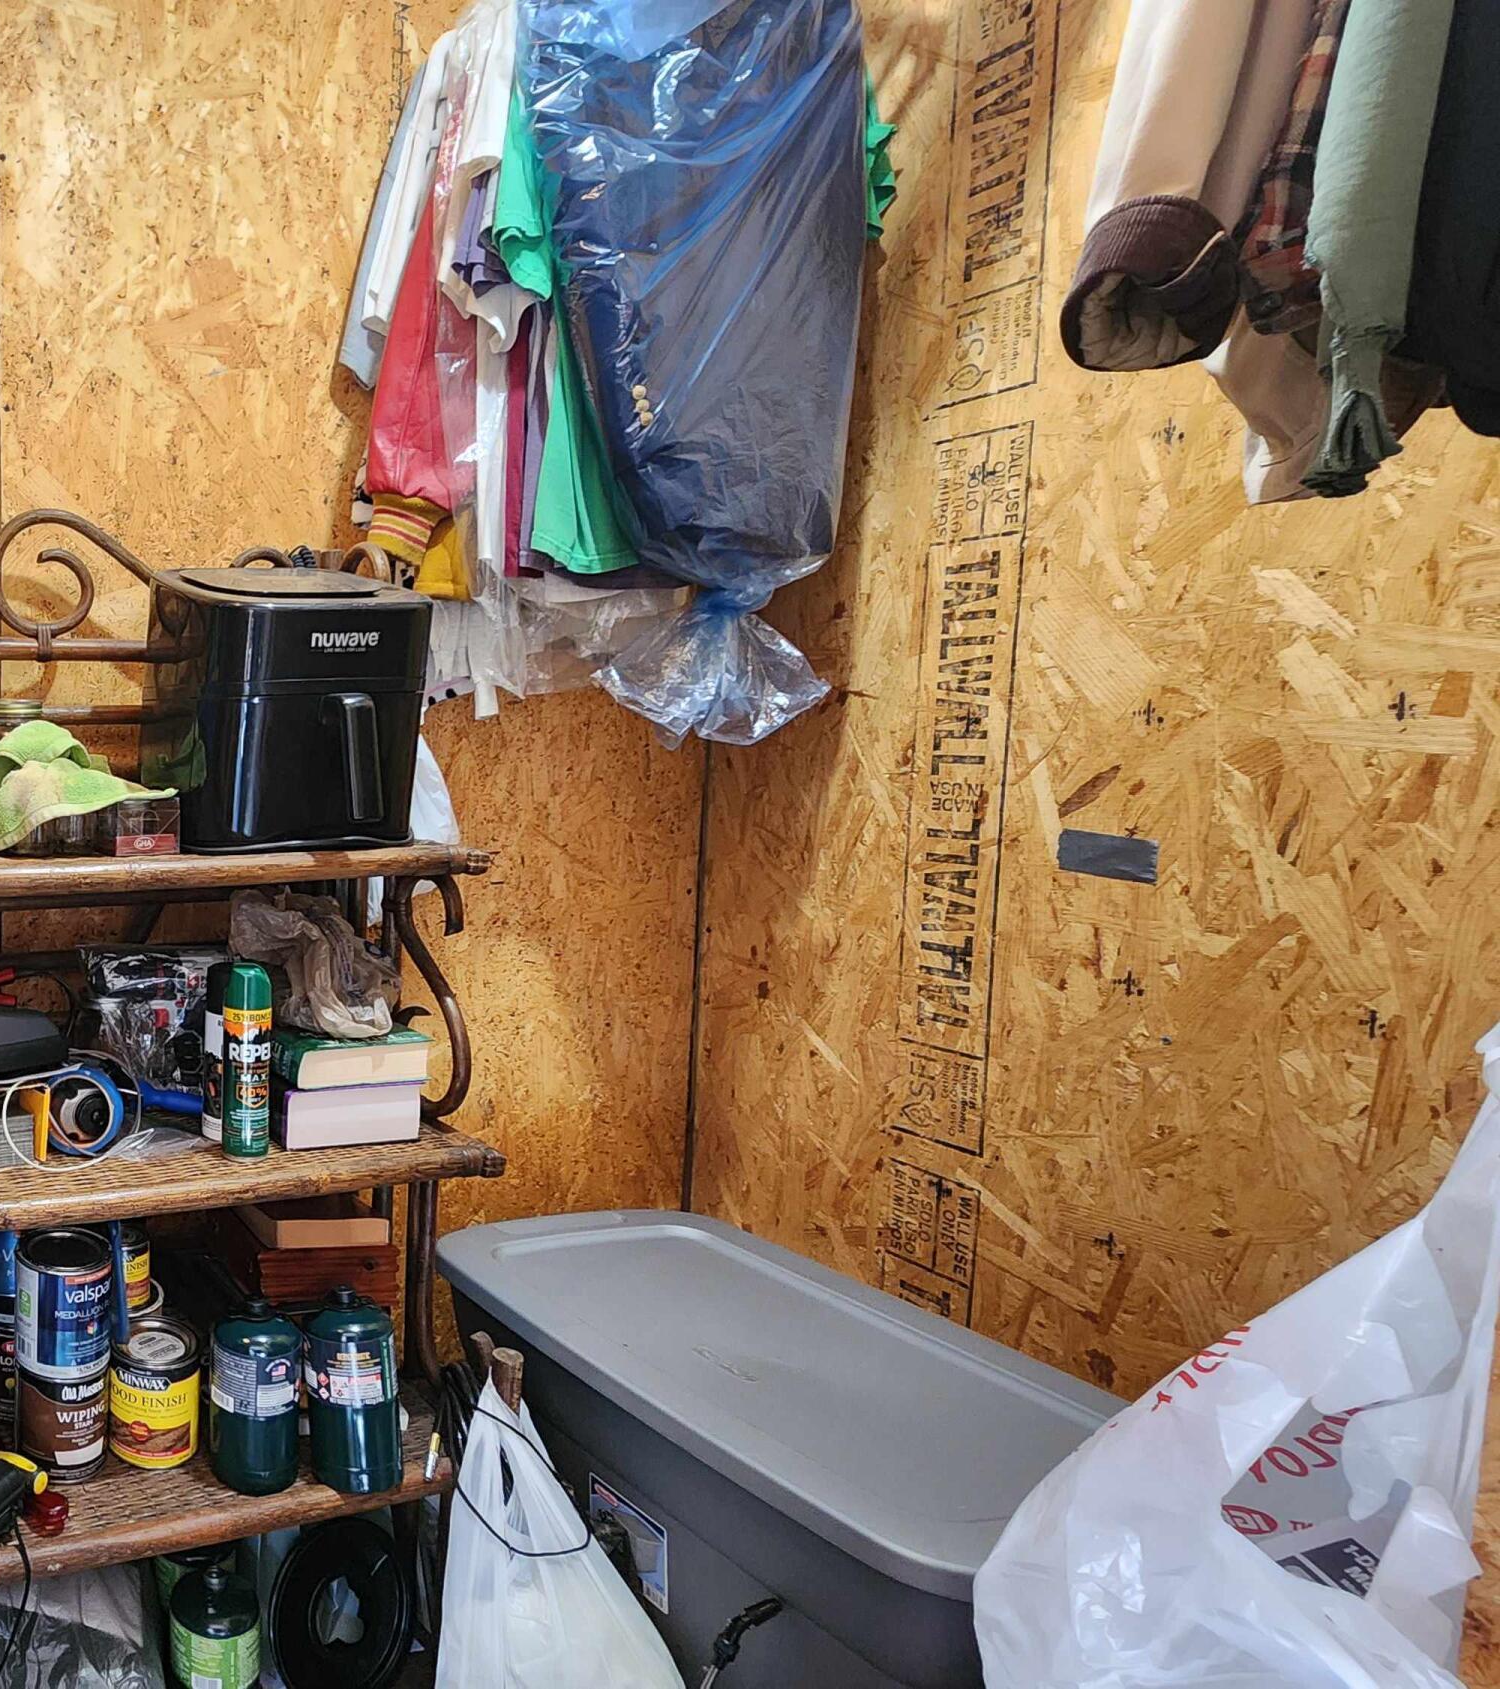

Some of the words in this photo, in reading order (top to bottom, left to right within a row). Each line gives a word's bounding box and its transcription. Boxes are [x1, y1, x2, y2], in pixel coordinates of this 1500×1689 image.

[1008, 435, 1025, 484] WALL
[966, 465, 980, 512] SOLO
[1005, 488, 1020, 526] USE
[311, 631, 379, 647] nuwave
[931, 551, 1000, 776] TALLWALL
[916, 819, 981, 1029] TALLWALL
[240, 1074, 267, 1082] MAX
[240, 1087, 267, 1098] 40%
[910, 1052, 937, 1101] SFI
[918, 1198, 933, 1243] SOLO
[957, 1195, 973, 1239] WALL
[953, 1242, 969, 1279] USE
[54, 1304, 105, 1320] MEDALLION
[111, 1384, 137, 1404] OOD
[142, 1393, 187, 1408] FINISH
[118, 1370, 167, 1391] MINWAX
[56, 1400, 105, 1423] WIPING
[74, 1419, 94, 1430] STAIN
